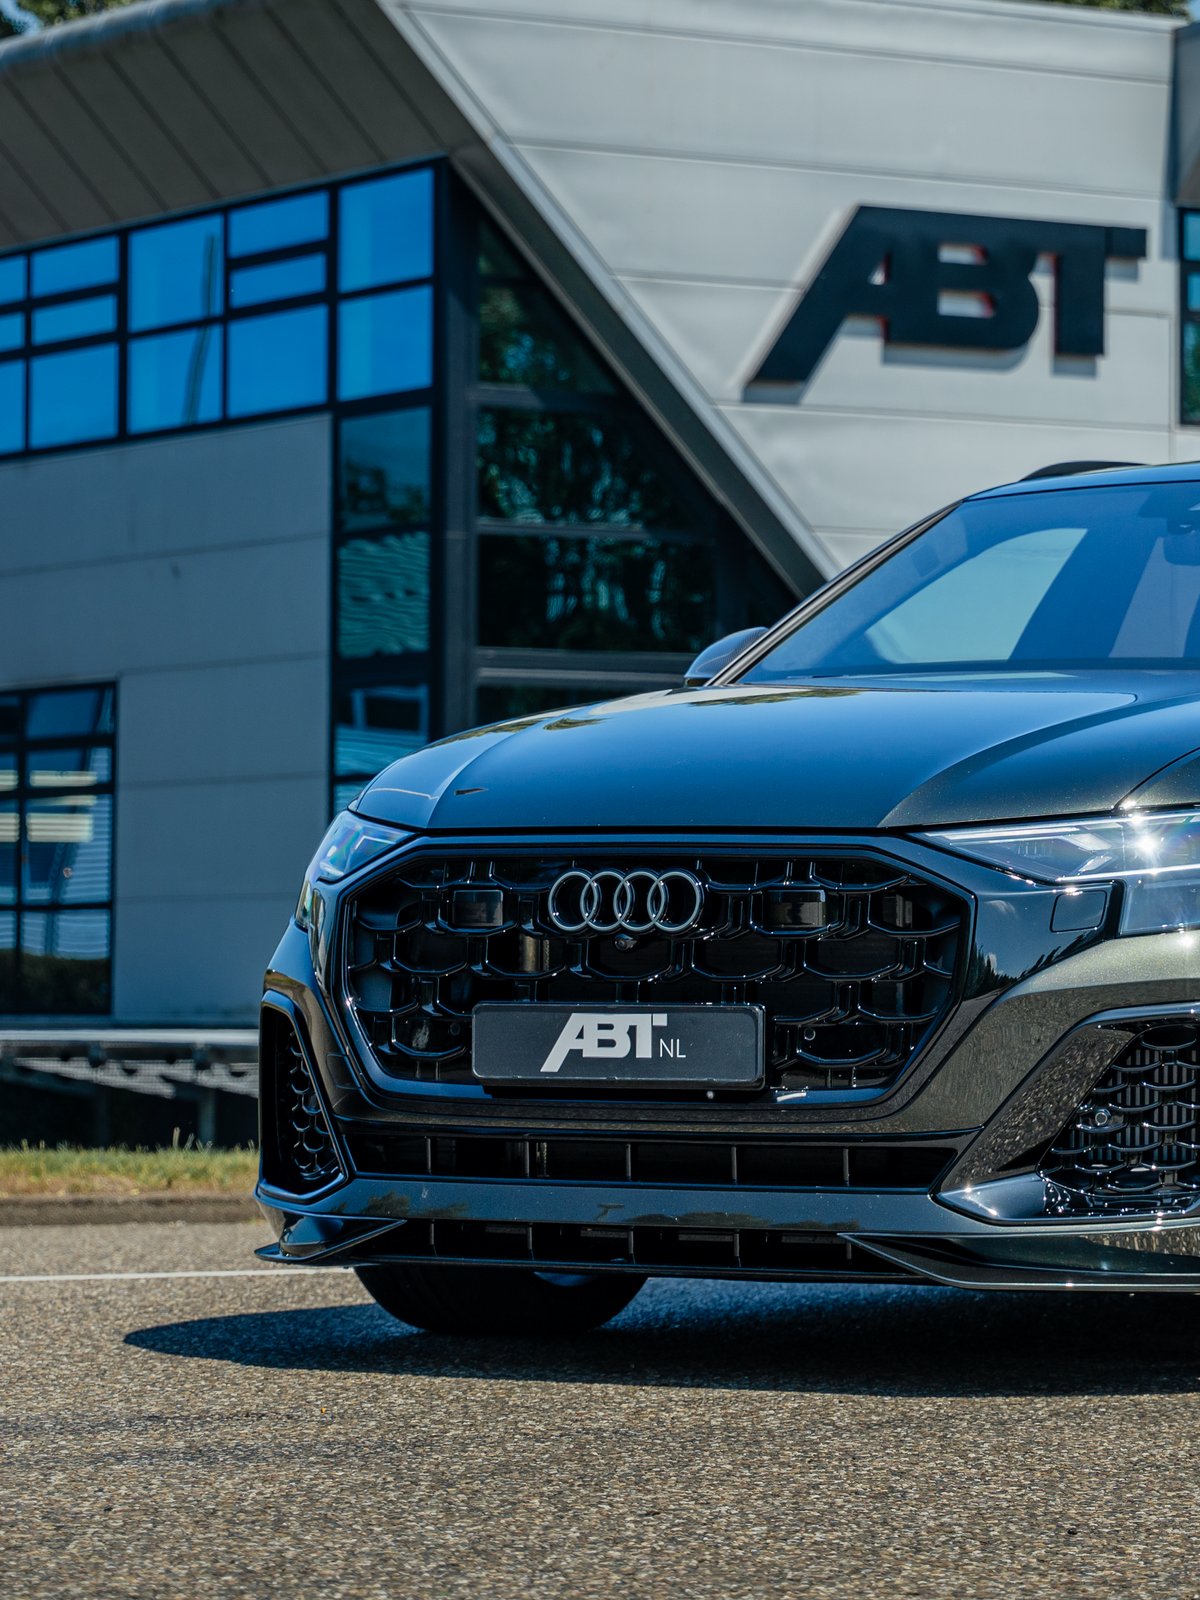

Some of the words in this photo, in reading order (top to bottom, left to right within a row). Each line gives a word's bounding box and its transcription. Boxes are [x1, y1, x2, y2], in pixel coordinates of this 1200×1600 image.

[745, 204, 1147, 386] ABT
[540, 1012, 668, 1073] ABT
[659, 1038, 687, 1059] NL
